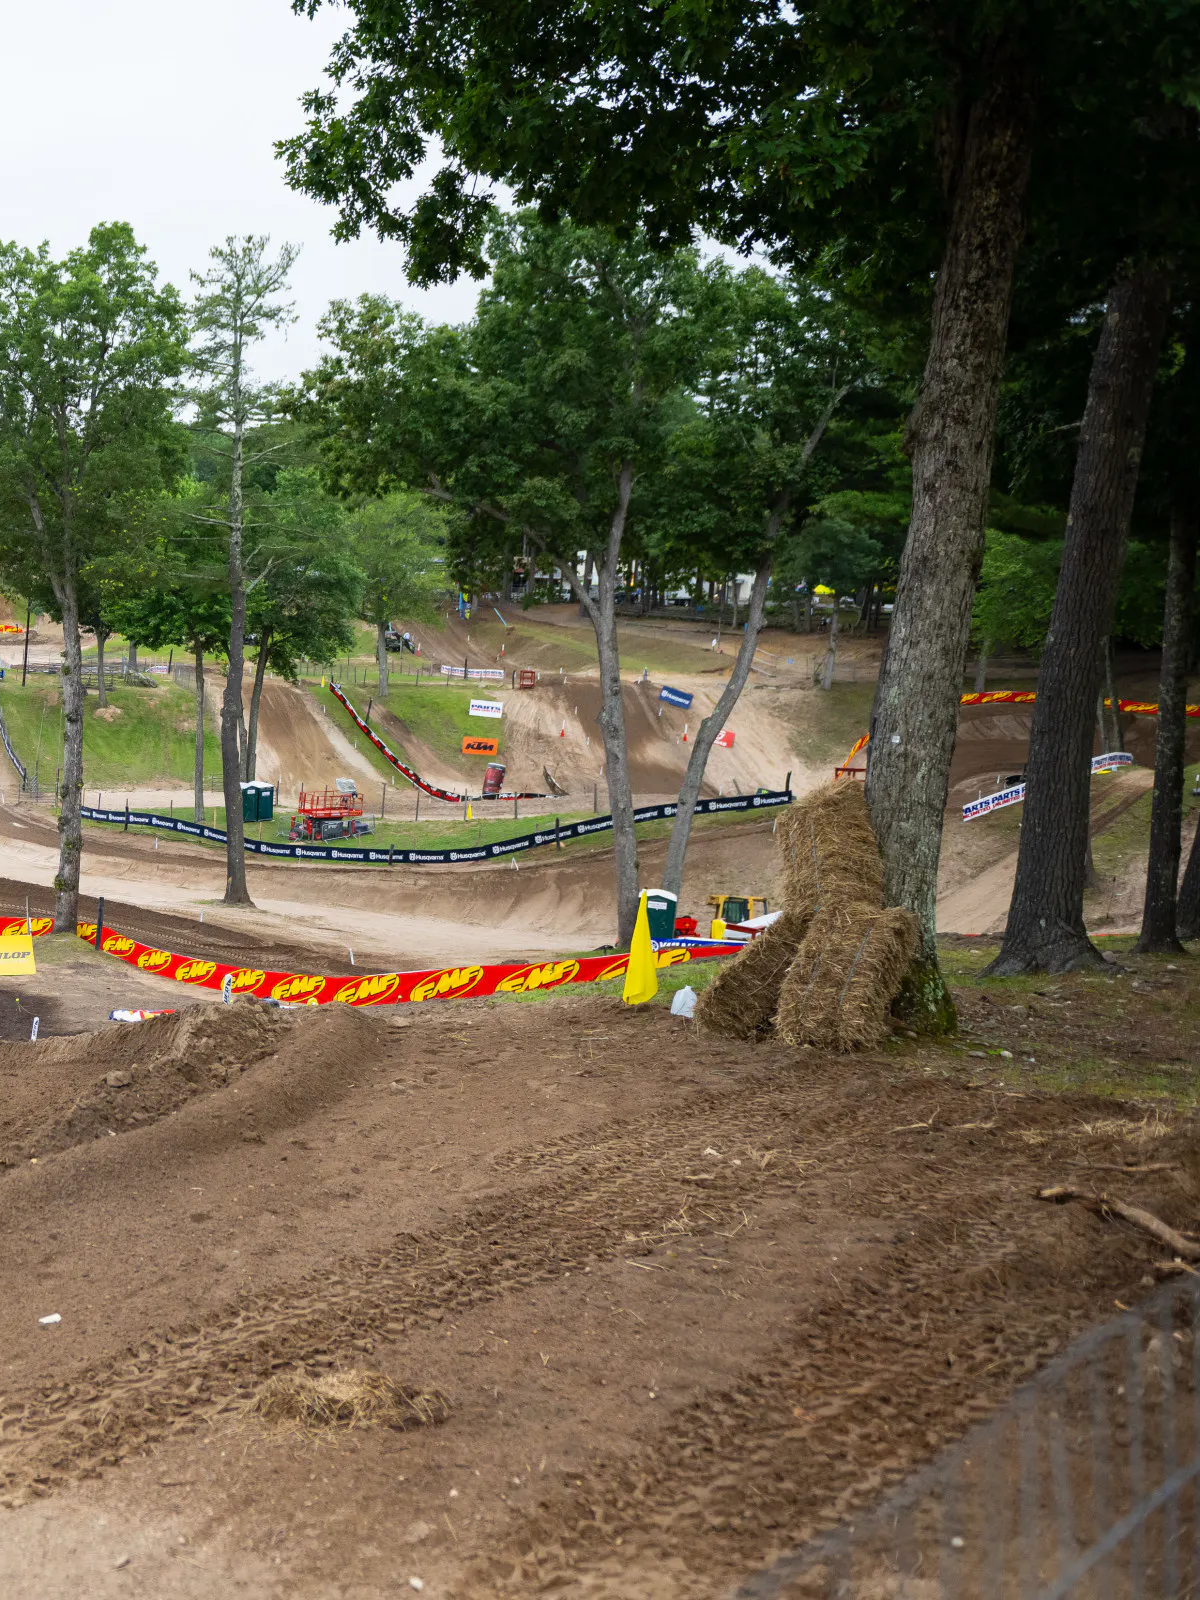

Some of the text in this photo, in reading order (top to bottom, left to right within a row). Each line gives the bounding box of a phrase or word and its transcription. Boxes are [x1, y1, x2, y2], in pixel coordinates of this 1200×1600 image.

[465, 741, 494, 751] KTM
[992, 788, 1020, 803] PARTS
[457, 850, 486, 859] Husqvarna
[500, 840, 529, 852] Husqvarna
[103, 937, 135, 952] FMF
[138, 950, 172, 968] FMF
[175, 961, 216, 981] FMF
[497, 959, 580, 993] FMF
[273, 975, 326, 1000] FMF
[336, 973, 400, 1003] FMF
[410, 965, 482, 1001] FMF
